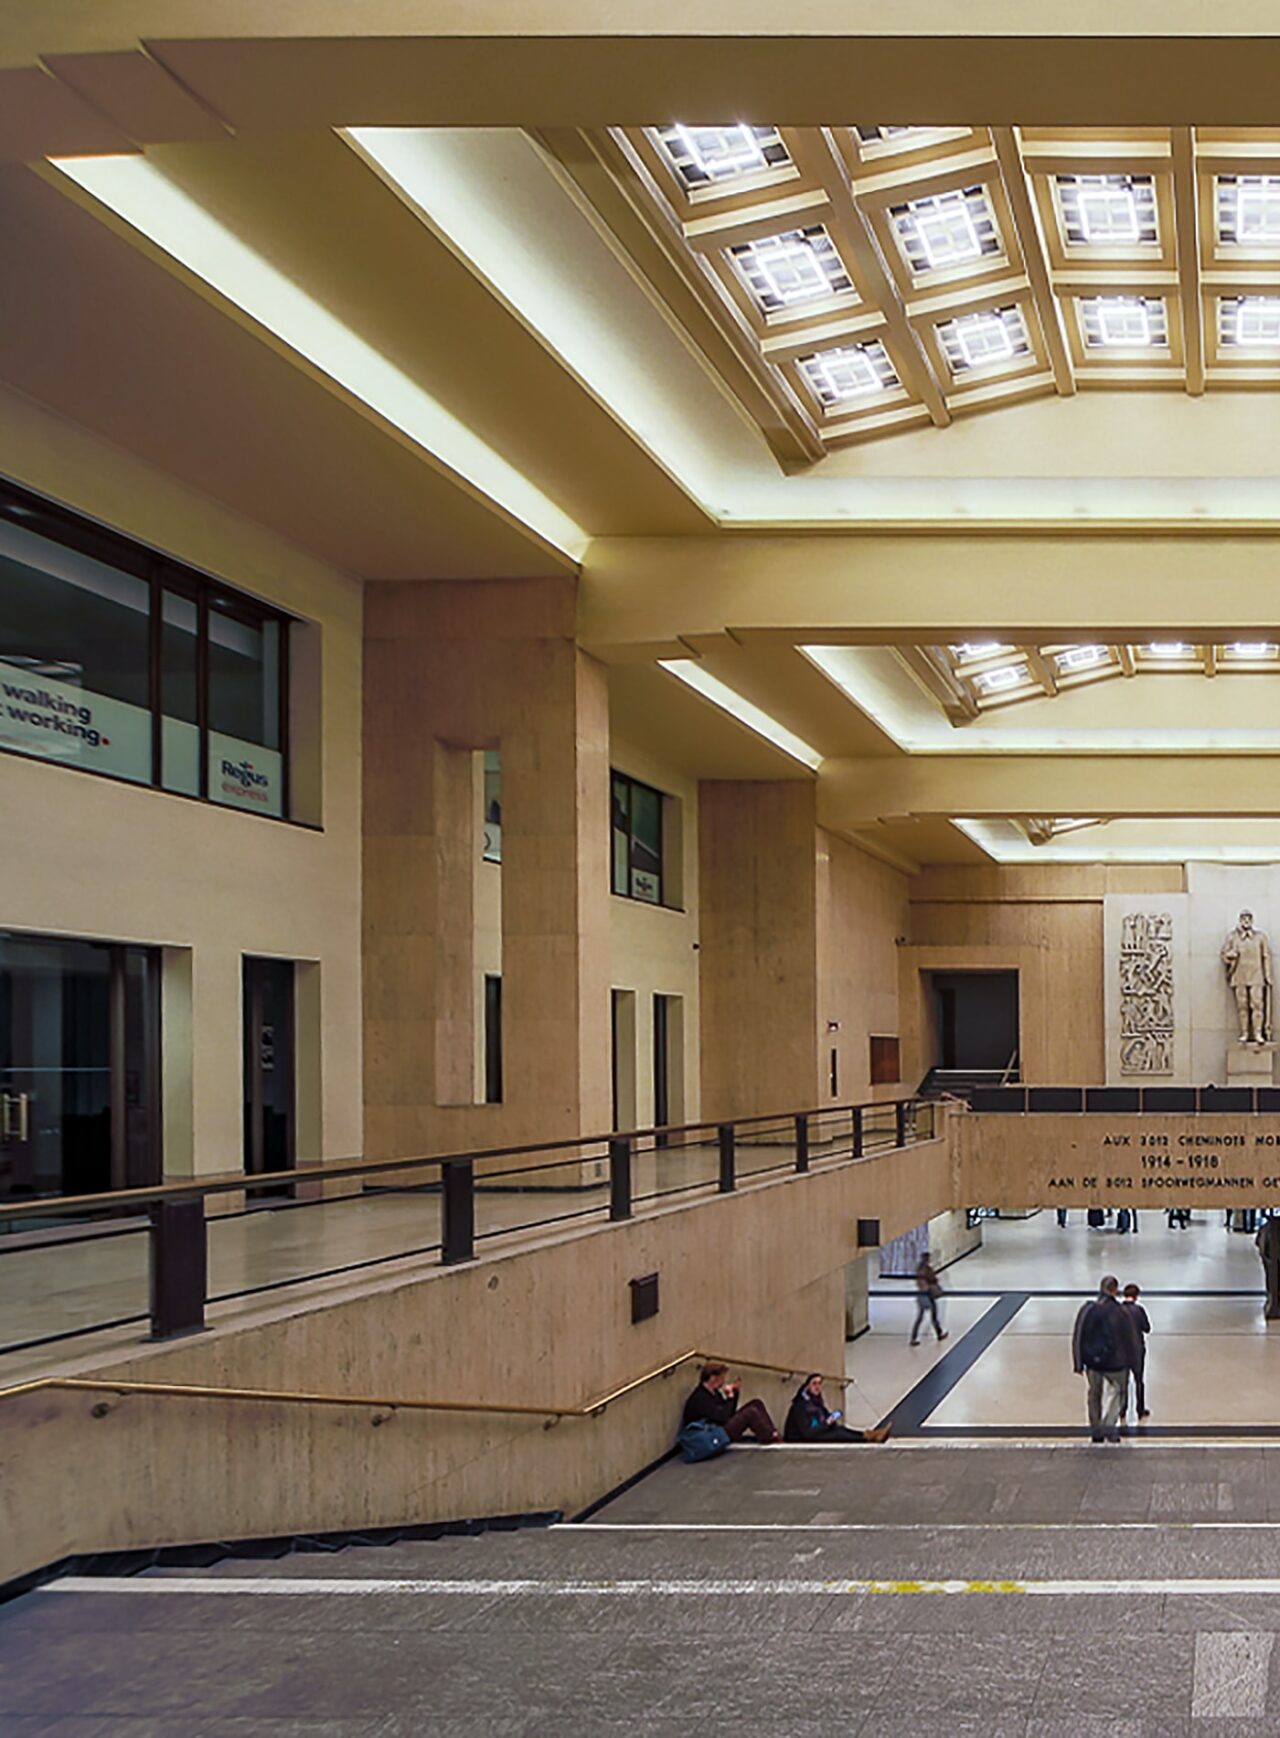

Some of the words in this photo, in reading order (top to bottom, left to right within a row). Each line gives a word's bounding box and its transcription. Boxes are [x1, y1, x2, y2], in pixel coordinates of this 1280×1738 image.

[2, 683, 92, 725] walking
[222, 760, 269, 787] Regus
[1103, 1135, 1131, 1147] AUX
[1178, 1135, 1246, 1147] CHEMINOTS
[1141, 1154, 1171, 1169] 1914
[1188, 1154, 1219, 1169] 1918
[1048, 1176, 1074, 1189] AAN
[1082, 1176, 1097, 1189] DE
